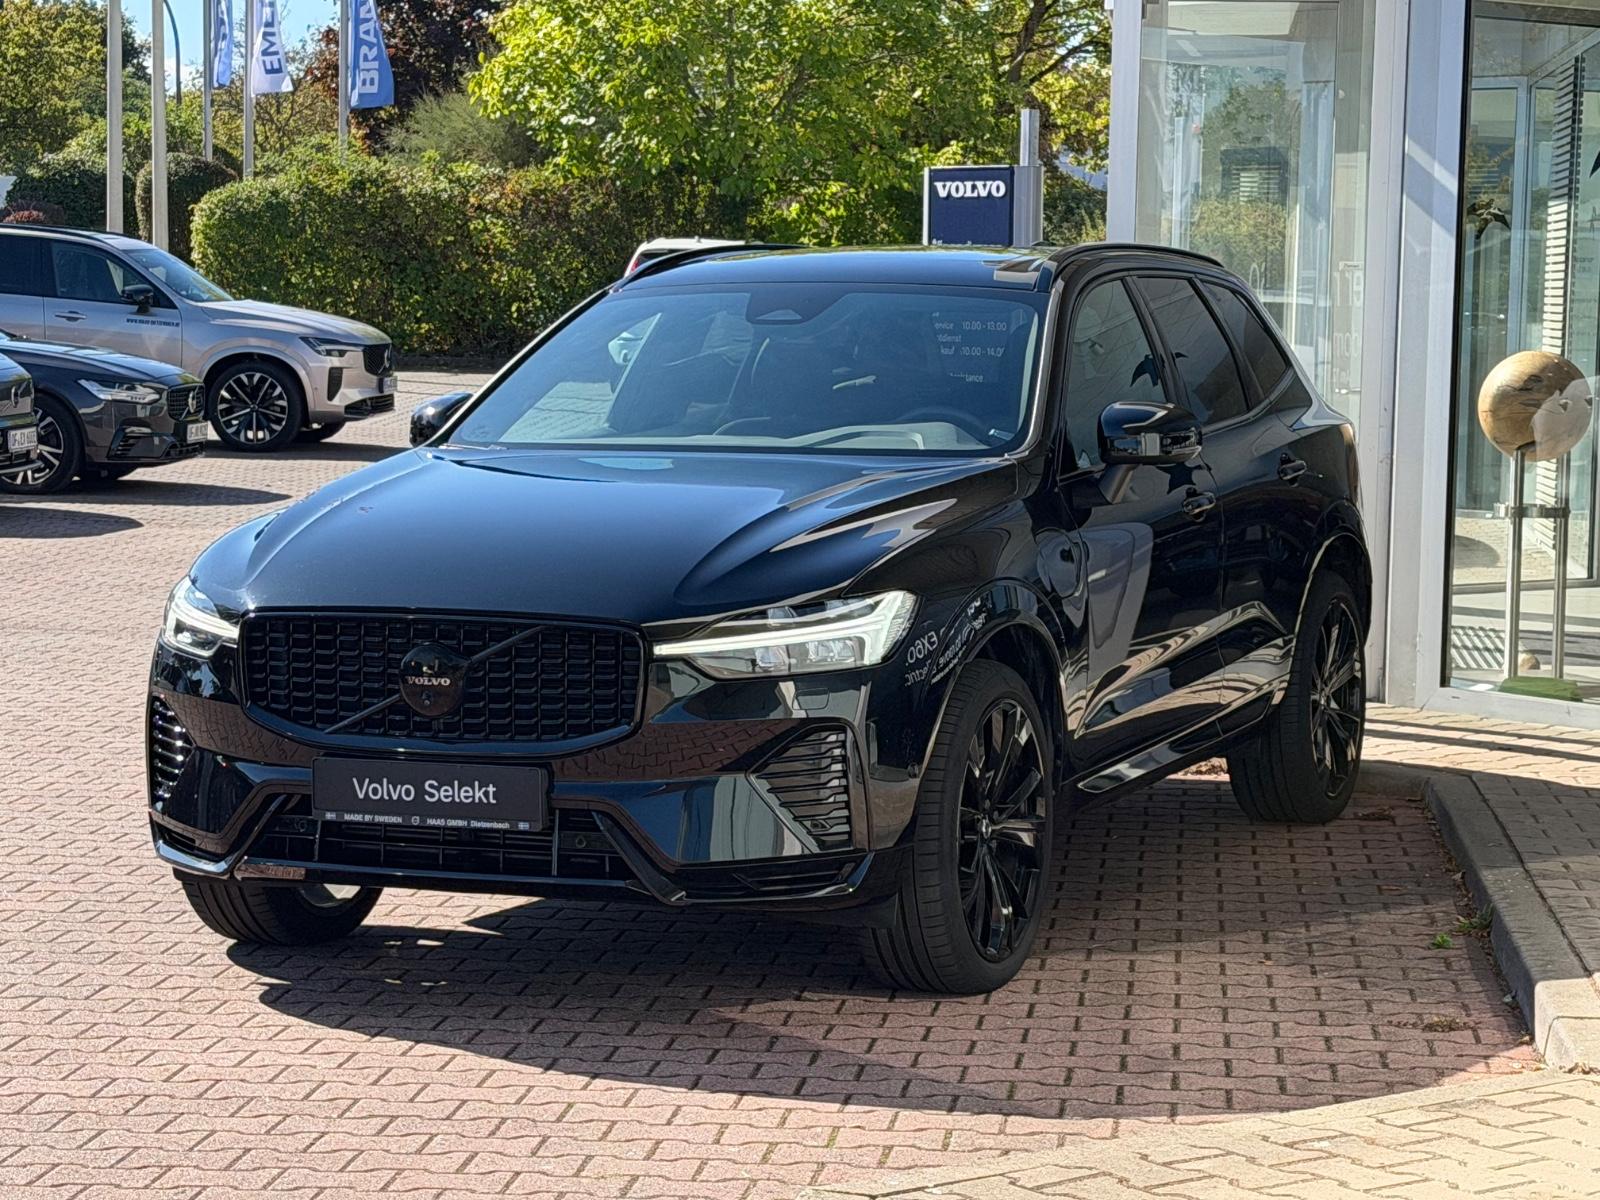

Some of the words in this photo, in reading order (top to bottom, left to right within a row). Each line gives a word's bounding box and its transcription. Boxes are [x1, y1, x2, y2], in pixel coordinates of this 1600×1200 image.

[934, 181, 1006, 198] VOLVO
[407, 676, 450, 686] VOLVO
[352, 777, 415, 801] Volvo
[424, 780, 497, 804] Selekt
[344, 812, 363, 821] MADE
[364, 814, 374, 822] BY
[374, 815, 402, 823] SWEDEN
[426, 817, 445, 826] HAAS
